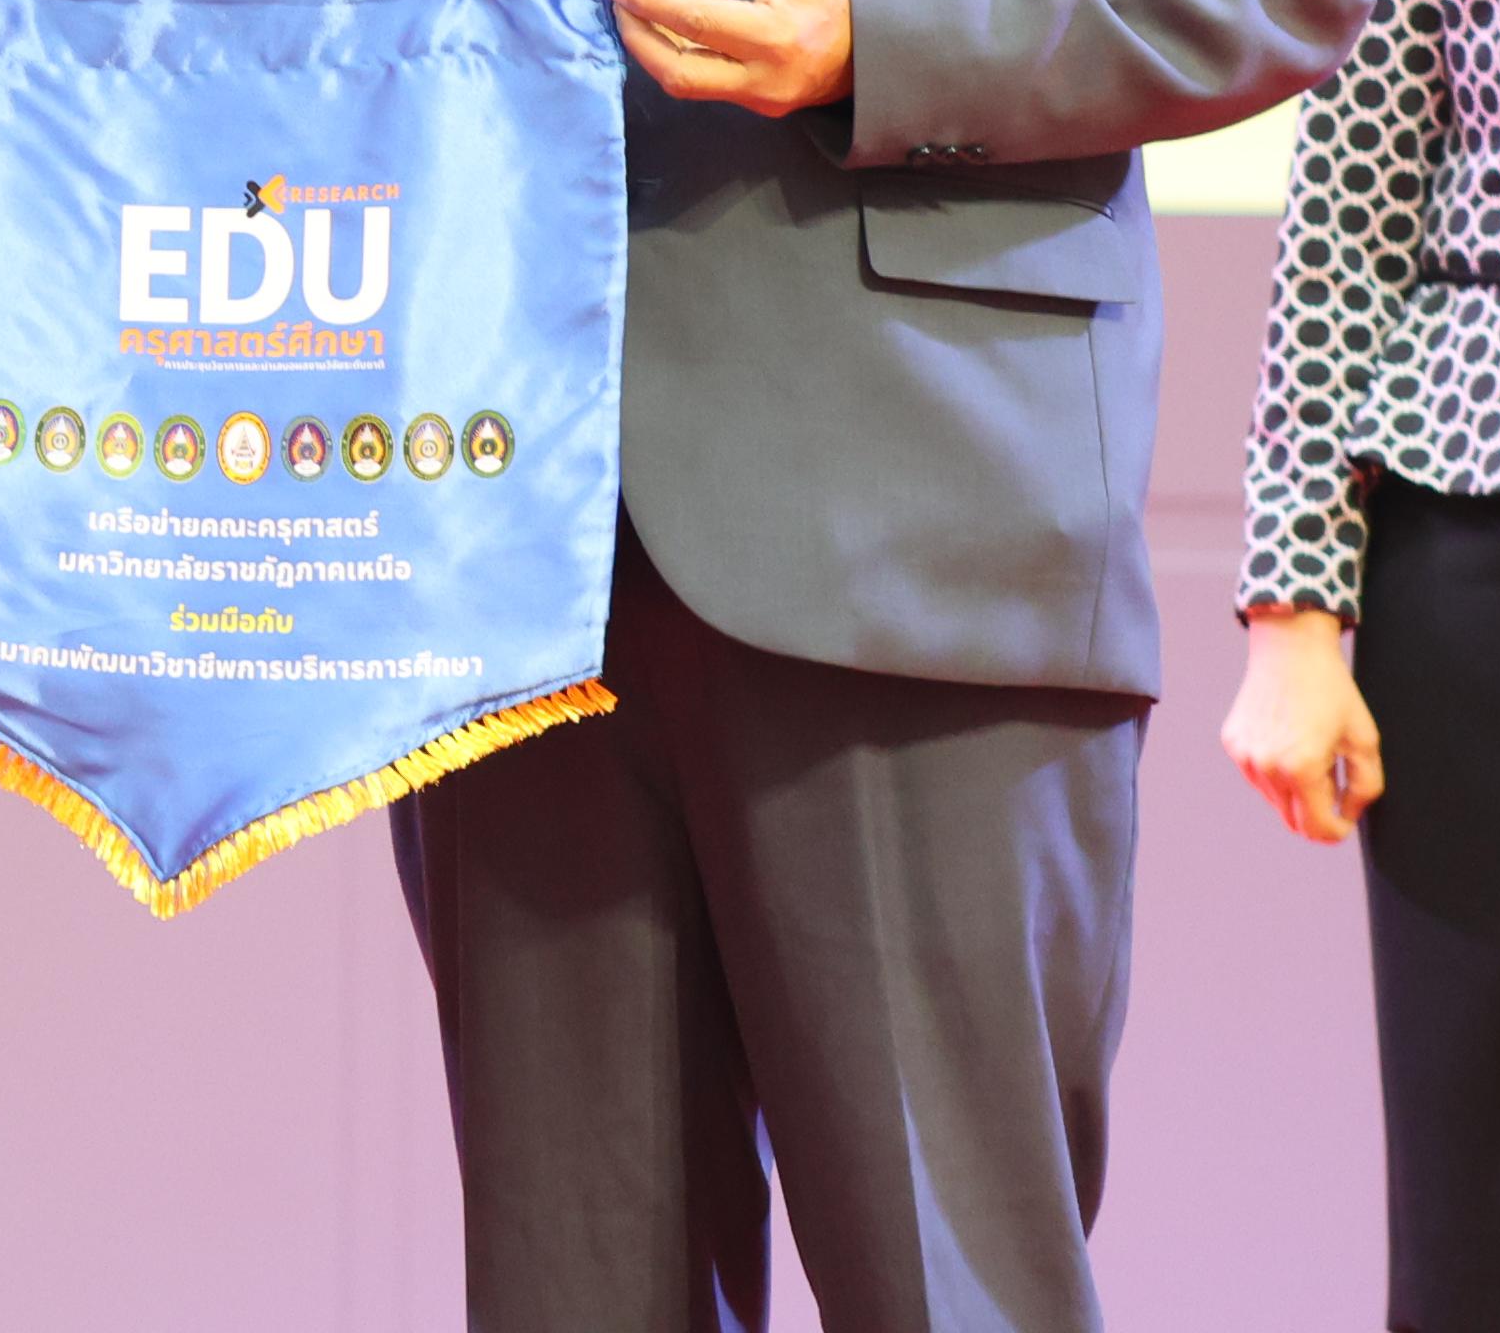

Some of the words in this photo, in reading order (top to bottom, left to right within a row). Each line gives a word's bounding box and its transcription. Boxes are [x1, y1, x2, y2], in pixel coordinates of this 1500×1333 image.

[288, 183, 400, 203] RESEARCH
[118, 203, 392, 326] EDU
[118, 320, 386, 367] ครุศาสตร์ศึกษา
[87, 506, 381, 546] เครือข่ายคณะครุศาสตร์
[57, 549, 412, 589] มหาวิทยาลัยราชภัฏภาคเหนือ
[169, 602, 295, 635] ร่วมมือกับ
